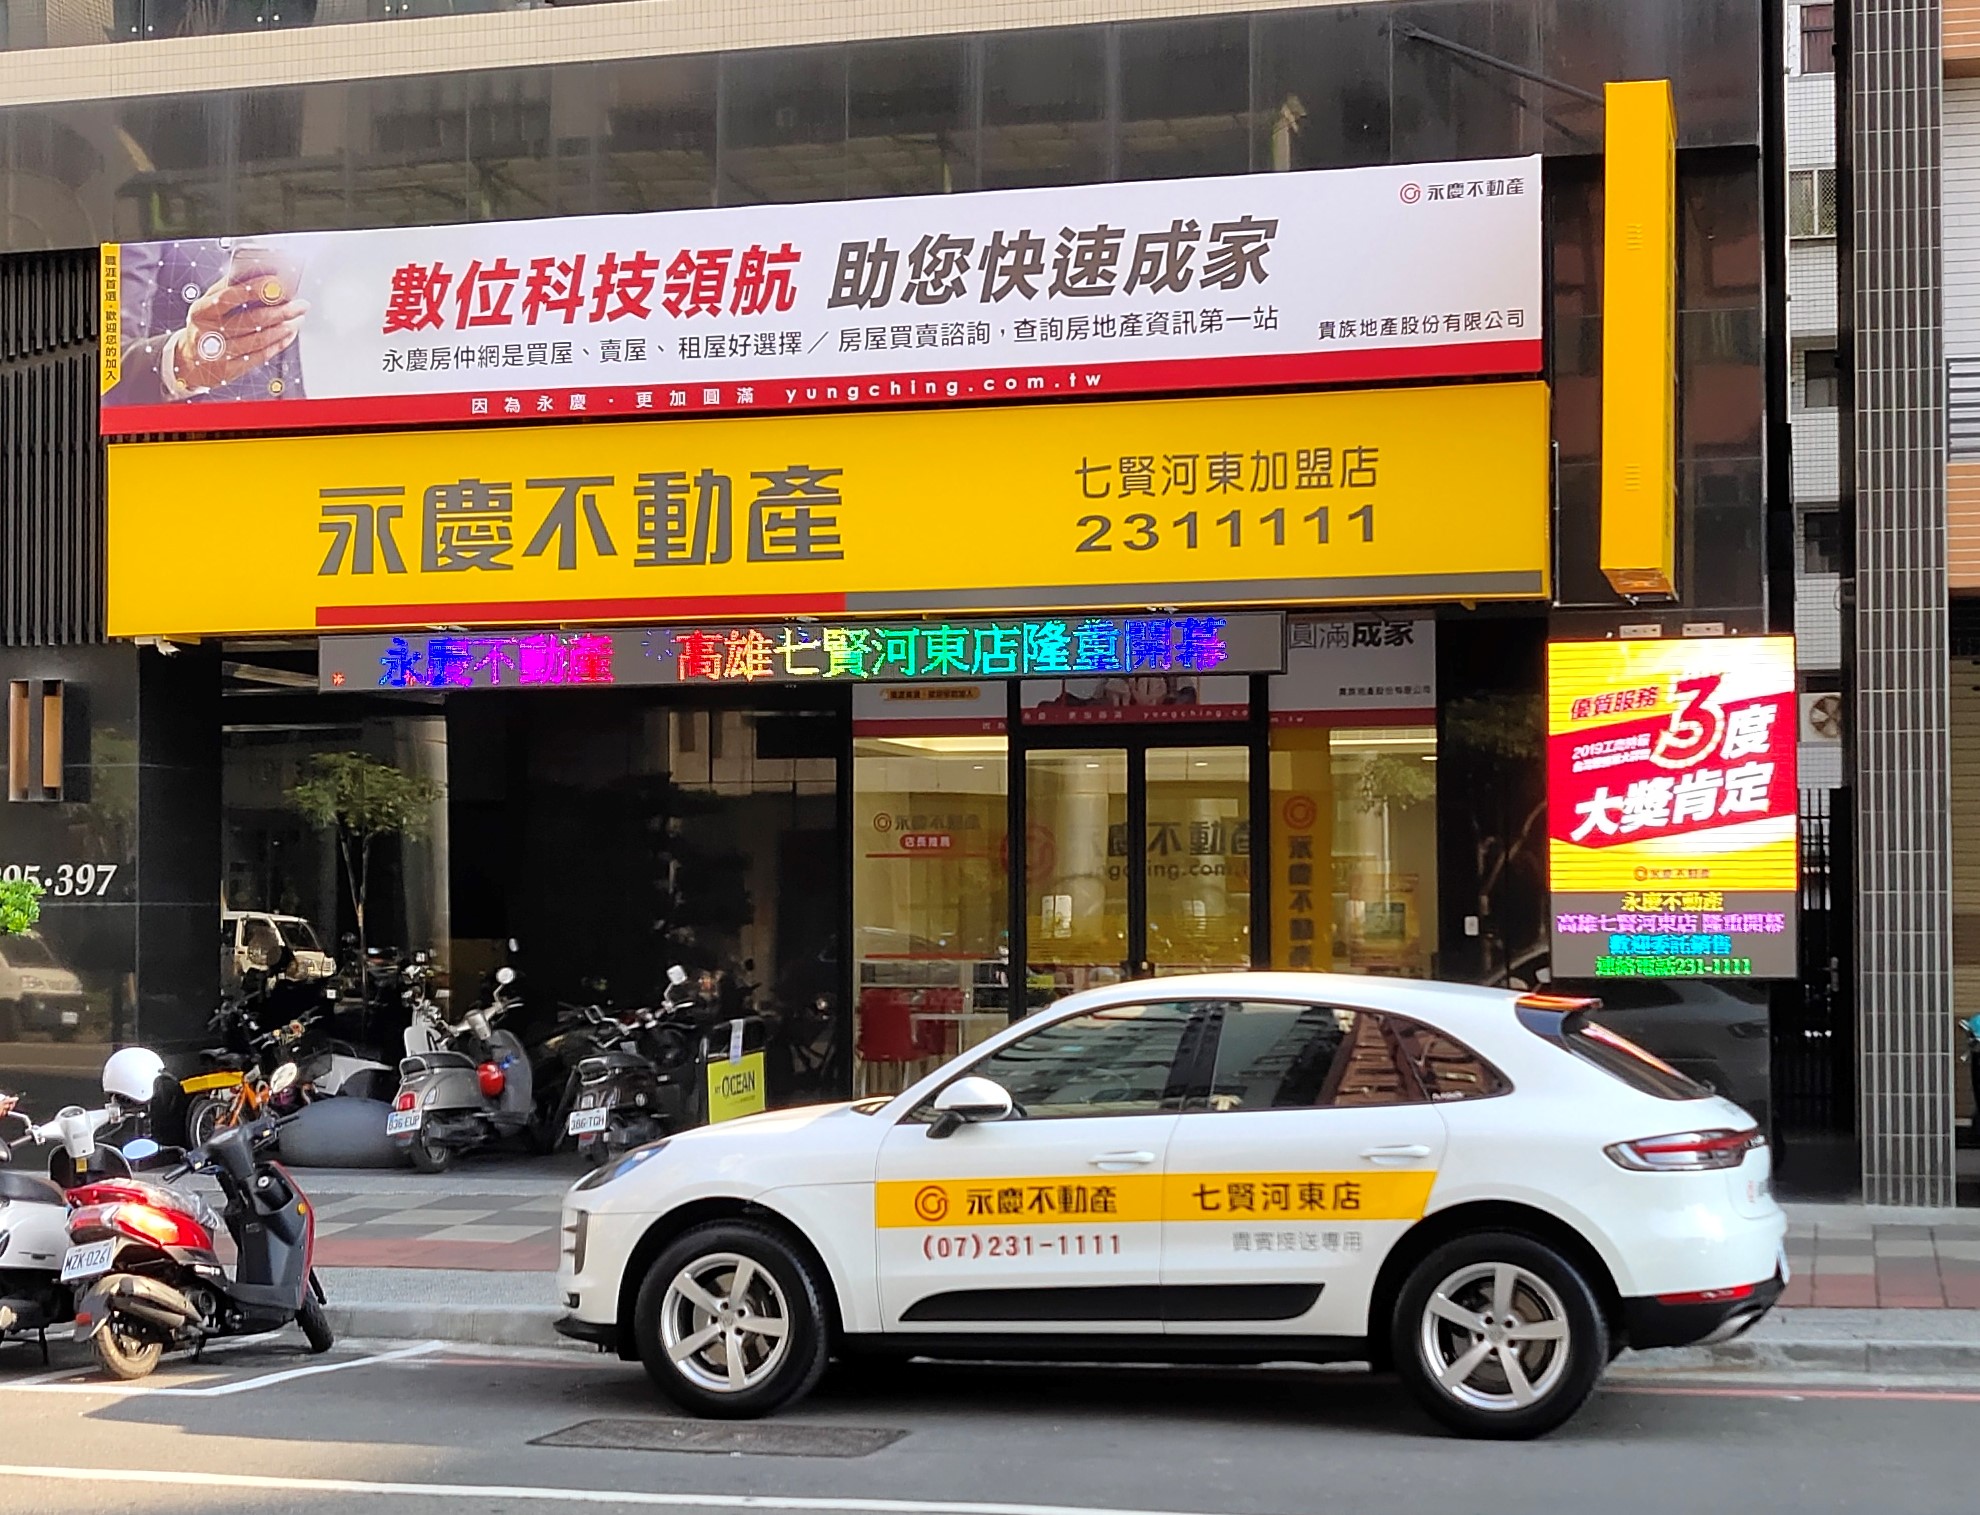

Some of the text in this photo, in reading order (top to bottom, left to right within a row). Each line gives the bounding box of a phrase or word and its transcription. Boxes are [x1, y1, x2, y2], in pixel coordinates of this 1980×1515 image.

[1427, 177, 1525, 201] 永慶不動產
[382, 215, 1279, 334] 數位科技領航 助您快速成家
[1318, 309, 1525, 340] 貴族地產股份有限公司
[785, 372, 1102, 404] yungching.com.tw
[1074, 445, 1380, 499] 七賢河東加盟店
[317, 465, 845, 577] 永慶不動產
[1074, 504, 1375, 553] 2311111
[1570, 761, 1774, 841] 大獎肯定
[1621, 891, 1725, 912] 永慶不動產
[1556, 914, 1698, 934] 高雄七賢河東店
[722, 1069, 756, 1100] OCEAN
[966, 1181, 1363, 1216] 永慶不動產 七賢河東店
[922, 1234, 1121, 1261] (07)231-1111
